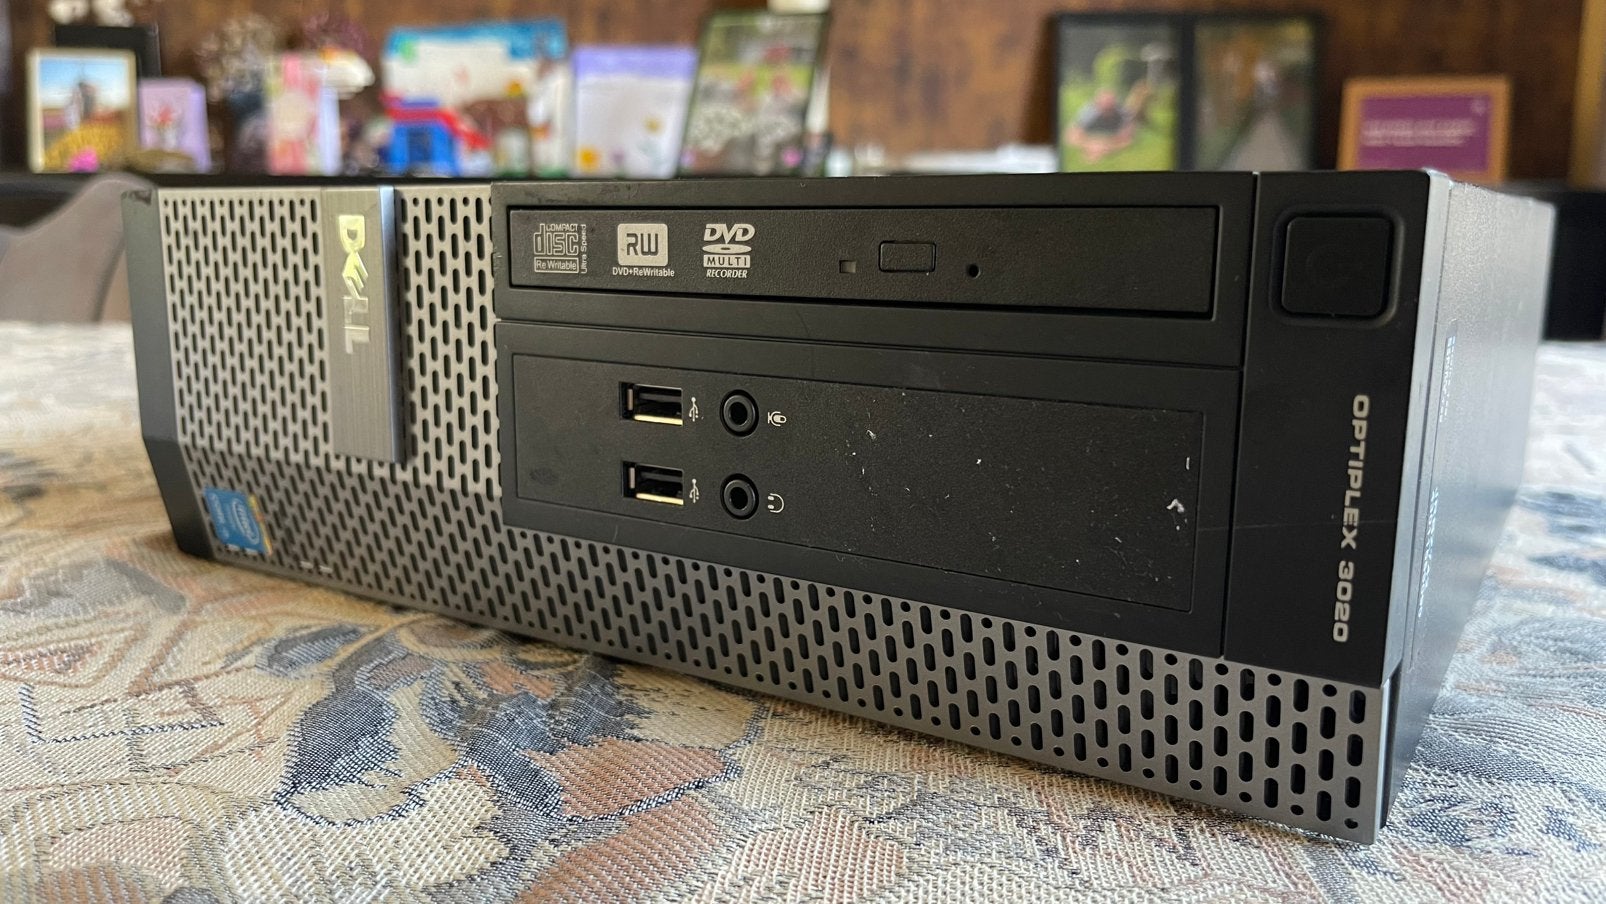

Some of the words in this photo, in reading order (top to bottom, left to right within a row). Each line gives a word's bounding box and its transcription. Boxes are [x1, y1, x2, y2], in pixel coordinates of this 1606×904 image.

[546, 223, 578, 232] COMPACT
[580, 223, 588, 252] Speed
[703, 223, 756, 244] DVD
[626, 232, 659, 256] RW
[580, 254, 588, 274] Ultra
[612, 266, 675, 277] DVD+ReWritable
[706, 256, 747, 267] MULTI
[706, 269, 748, 279] RECORDER
[338, 215, 370, 355] DELL
[1340, 394, 1370, 550] OPTIPLEX
[1332, 560, 1355, 643] 3020
